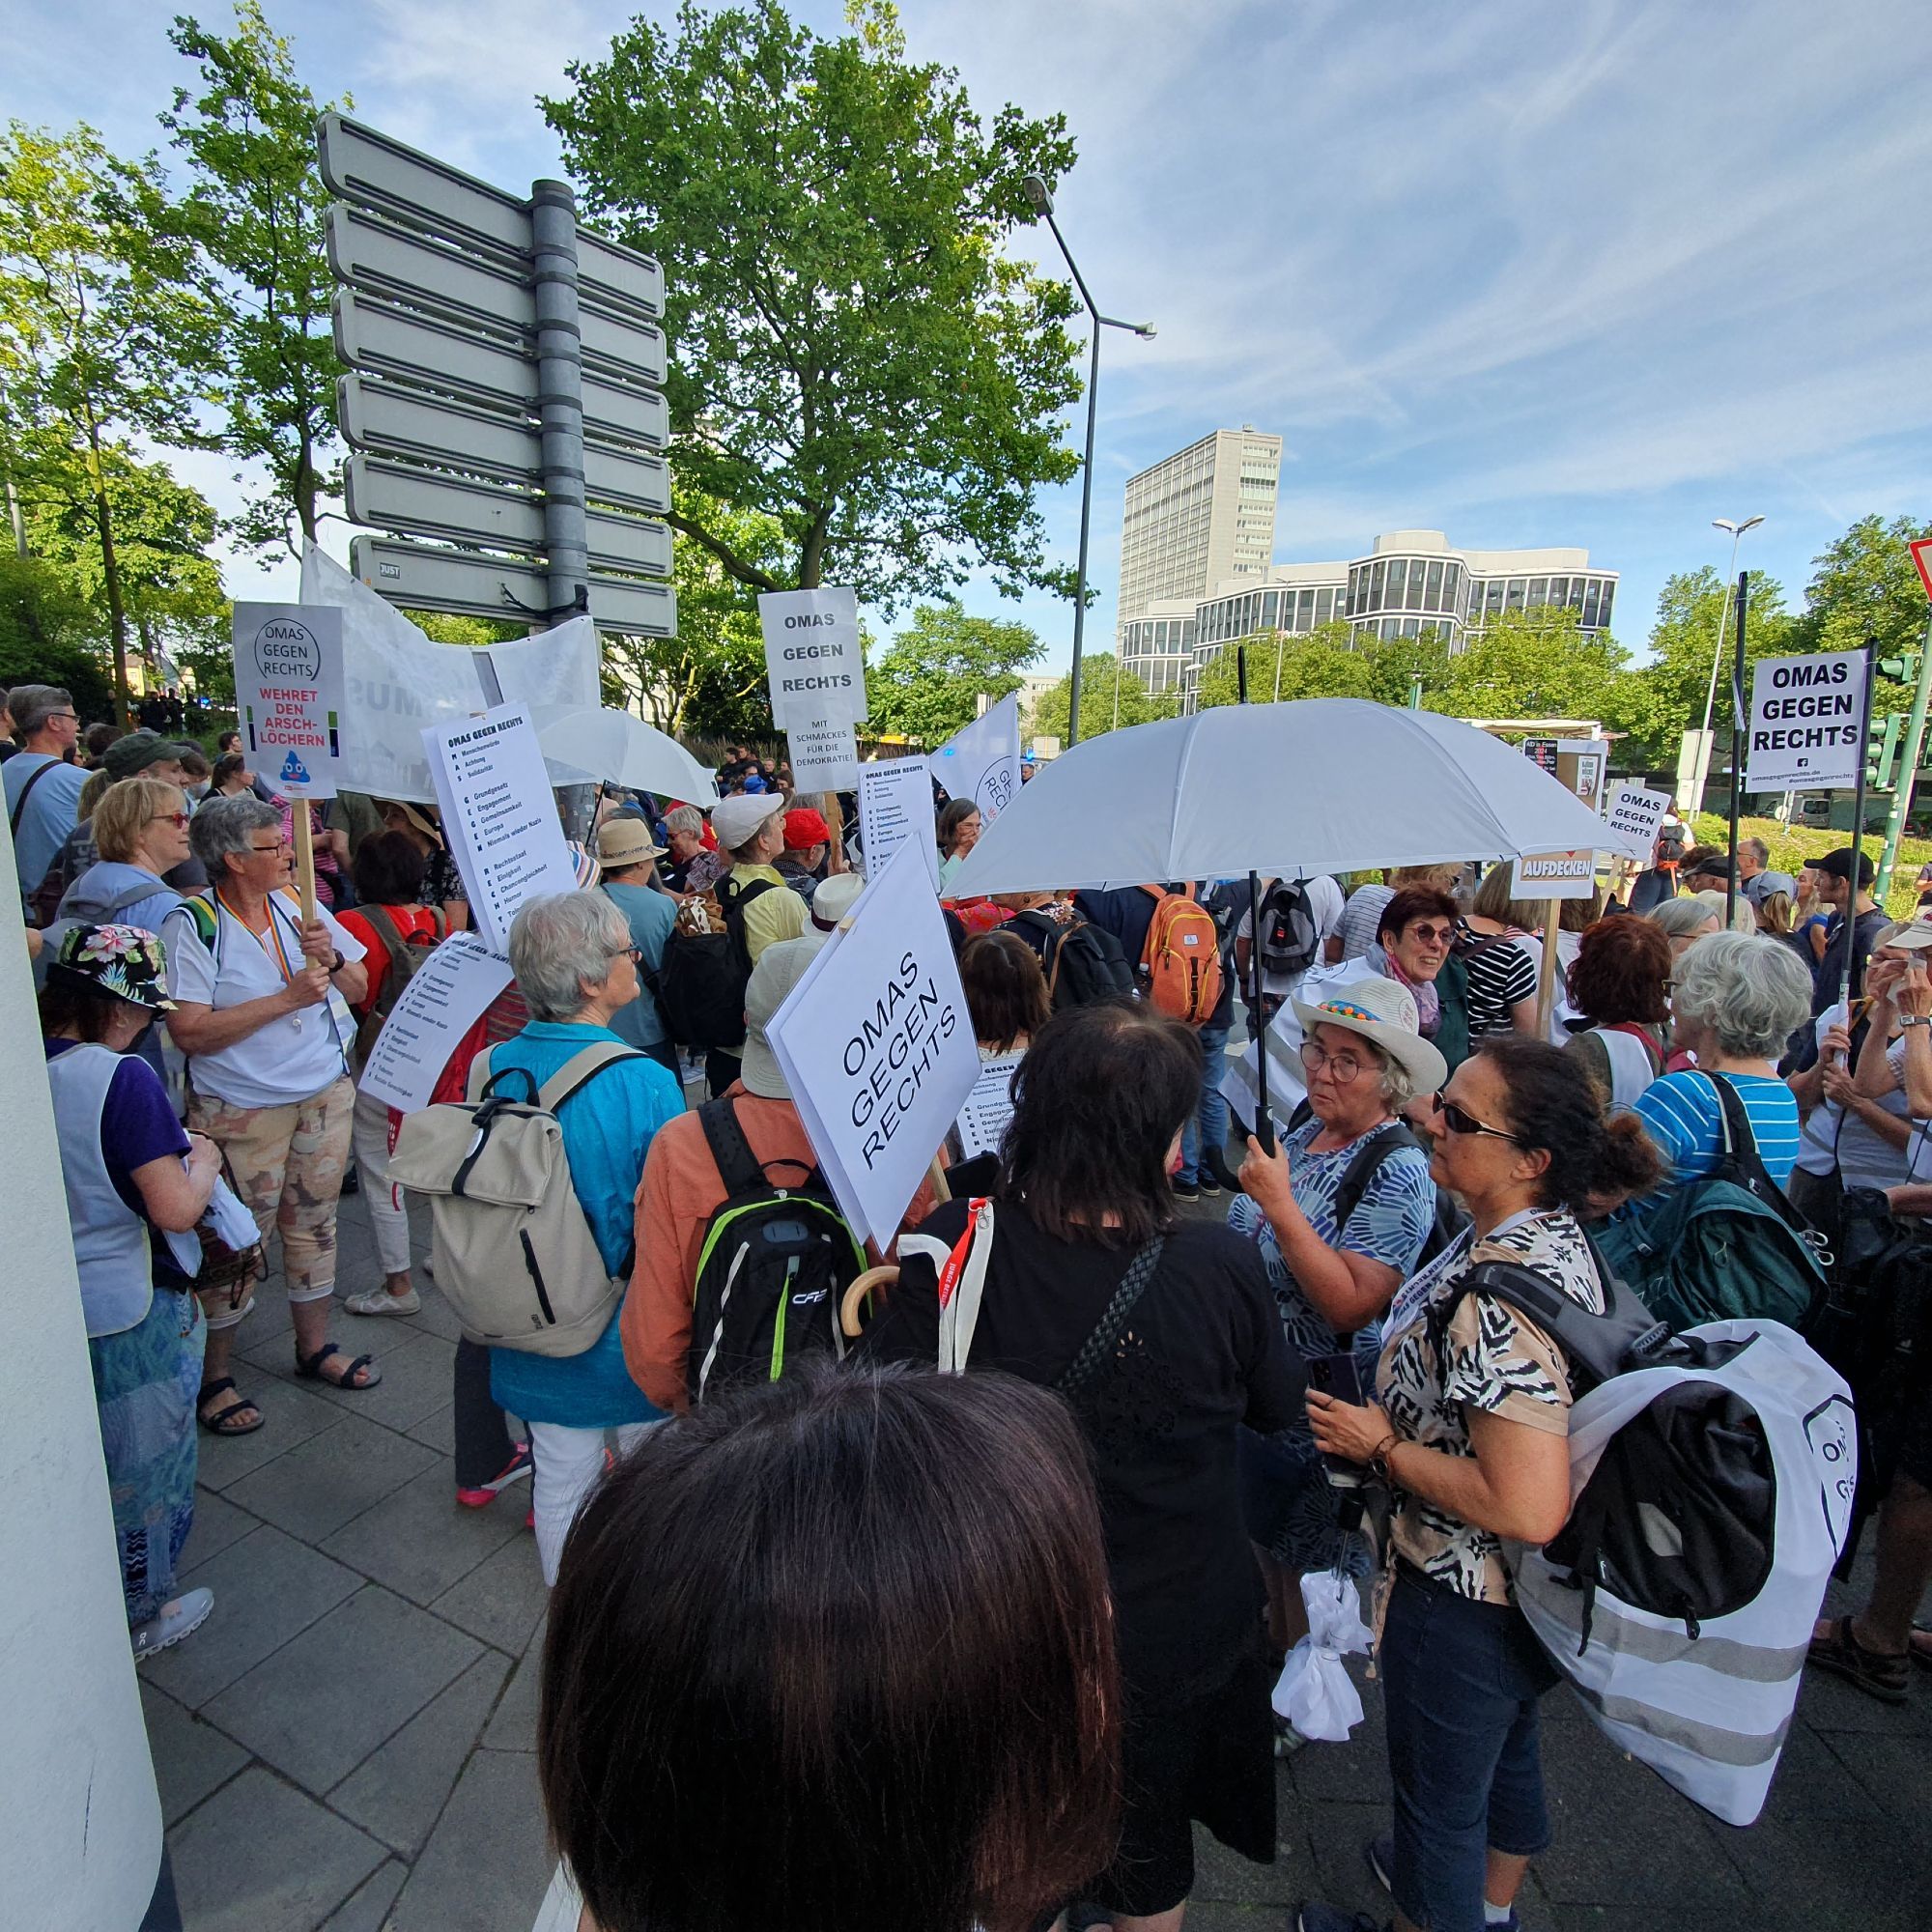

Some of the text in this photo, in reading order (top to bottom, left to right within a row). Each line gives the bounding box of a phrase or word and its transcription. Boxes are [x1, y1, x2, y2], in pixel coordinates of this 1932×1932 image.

[784, 613, 835, 629] OMAS
[265, 626, 304, 640] OMAS
[263, 644, 308, 659] GEGEN
[783, 644, 843, 661] GEGEN
[264, 662, 313, 677] RECHTS
[1773, 662, 1848, 689] OMAS
[782, 674, 852, 692] RECHTS
[259, 688, 318, 702] WEHRET
[275, 703, 303, 716] DEN
[1762, 694, 1853, 721] GEGEN
[265, 717, 318, 730] ARSCH-
[811, 720, 828, 728] MIT
[259, 729, 326, 747] LÖCHERN
[448, 716, 523, 749] OMAS GEGEN RECHTS
[796, 730, 847, 742] SCHMACKES
[1753, 724, 1858, 751] RECHTS
[807, 744, 823, 753] FÜR
[796, 753, 853, 767] DEMOKRATIE!
[883, 768, 901, 777] GEGEN
[902, 765, 923, 774] RECHTS
[1751, 770, 1821, 781] omasgegenrechts.de
[1789, 773, 1854, 783] #omasgegenrechts
[473, 781, 509, 801] Grundgesetz
[477, 793, 512, 812] Engagement
[1620, 793, 1662, 811] OMAS
[480, 802, 523, 824] Gemeinsamkeit
[1614, 808, 1656, 825] GEGEN
[484, 823, 504, 837] Europa
[487, 833, 510, 848] Niemals
[510, 826, 528, 838] wieder
[1610, 820, 1652, 838] RECHTS
[494, 850, 527, 871] Rechtsstaat
[1523, 860, 1591, 877] AUFDECKEN
[497, 866, 522, 883] Einigkeit
[503, 892, 523, 905] Humor
[843, 951, 919, 1077] OMAS
[851, 978, 939, 1128] GEGEN
[984, 1065, 1015, 1074] GEGEN
[862, 1005, 956, 1171] RECHTS
[946, 1263, 957, 1283] JUNGE
[1409, 1282, 1433, 1304] GEGEN
